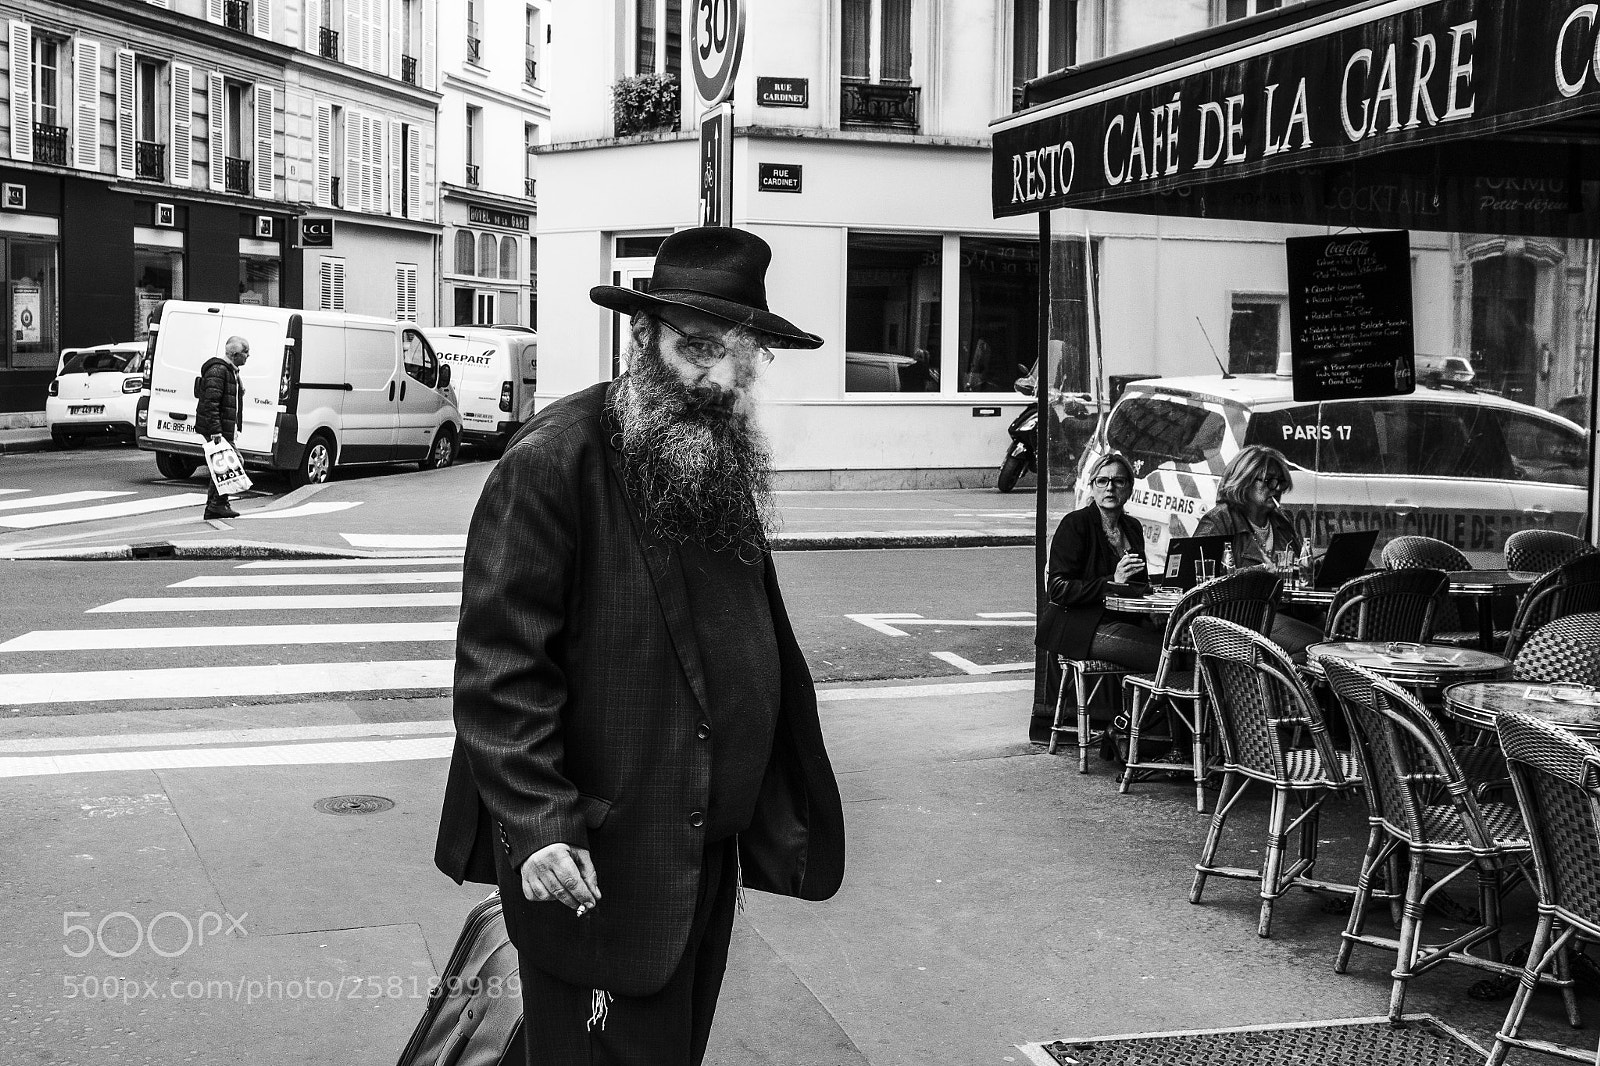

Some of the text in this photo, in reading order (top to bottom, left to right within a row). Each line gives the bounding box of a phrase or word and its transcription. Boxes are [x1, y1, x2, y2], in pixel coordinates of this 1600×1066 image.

[699, 0, 728, 60] 30
[774, 83, 792, 92] RUE
[763, 92, 804, 103] CARDINET
[1010, 3, 1600, 204] RESTO CAFÉ DE LA GARE C
[773, 169, 789, 177] RUE
[763, 177, 798, 187] CARDINET
[303, 224, 329, 234] LCL
[511, 215, 528, 229] GARE
[436, 352, 491, 365] OGEPART
[1282, 425, 1352, 441] PARIS 17
[212, 449, 239, 474] GO
[1151, 493, 1164, 508] DE
[1164, 496, 1195, 514] PARIS
[1284, 509, 1397, 547] OTECTION
[1402, 511, 1465, 550] CIVILE
[1469, 513, 1496, 550] DE
